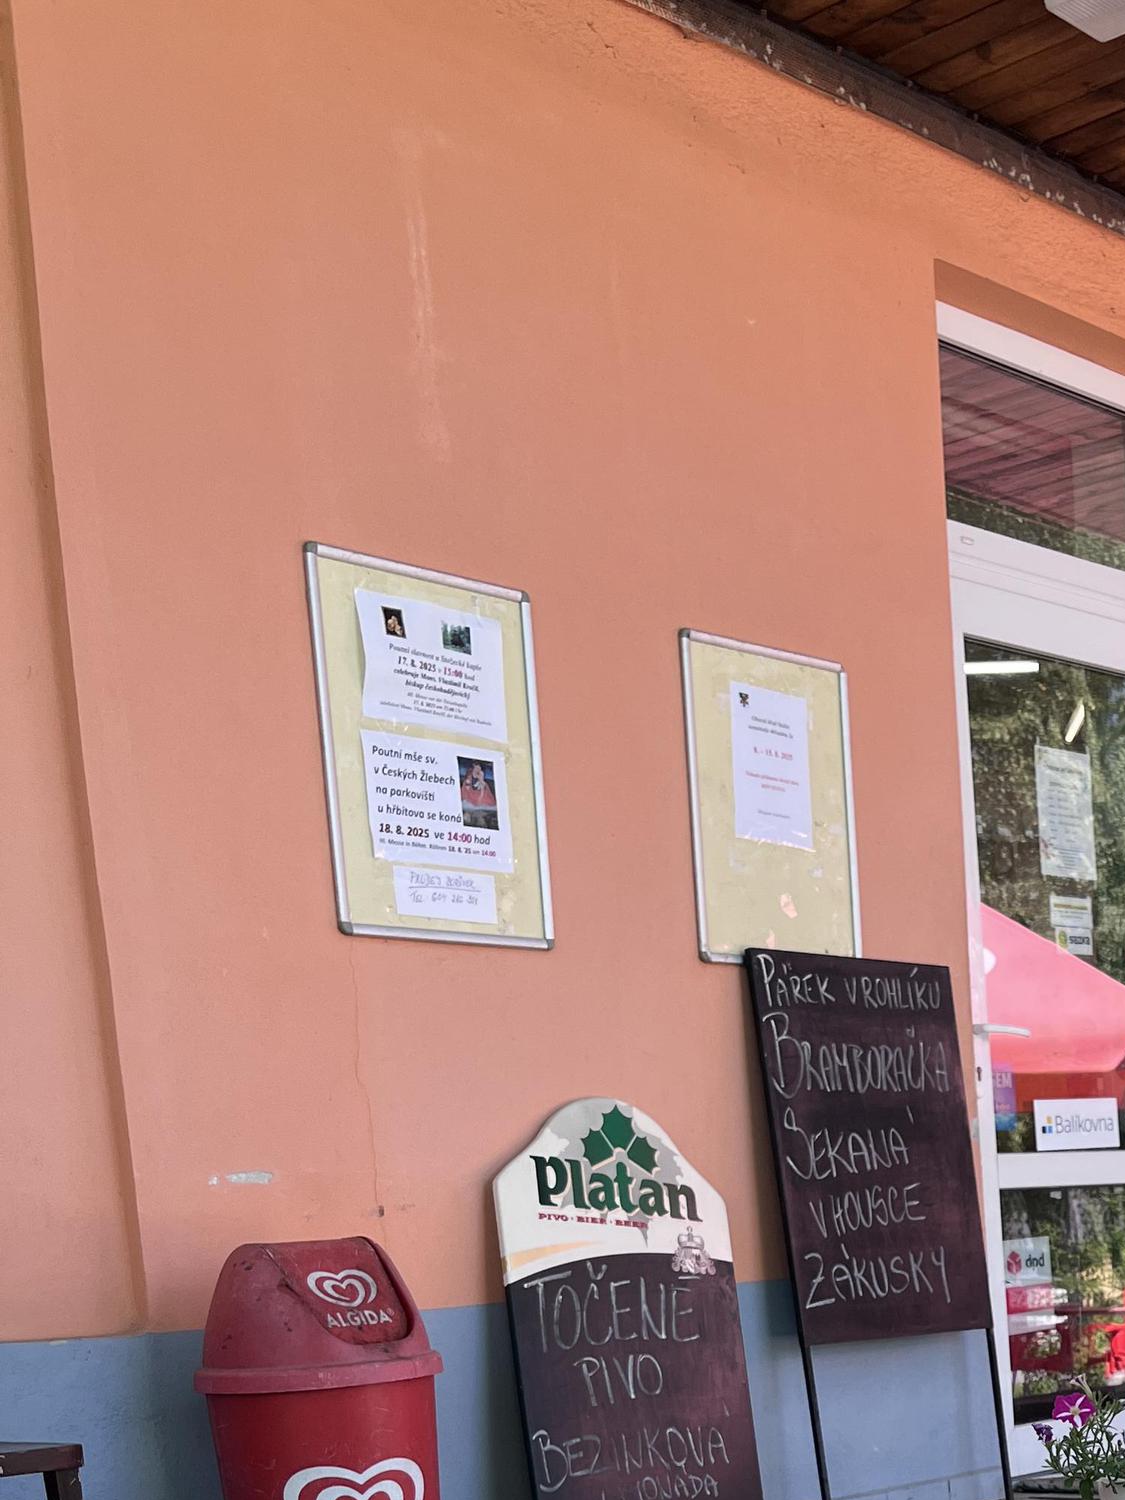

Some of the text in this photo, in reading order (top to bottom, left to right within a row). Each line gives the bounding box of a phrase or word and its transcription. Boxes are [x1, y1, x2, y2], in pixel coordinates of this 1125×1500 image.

[419, 661, 436, 672] 2025
[372, 745, 438, 765] Poutní mše sv.
[382, 763, 418, 780] Českých
[420, 770, 455, 785] Žlebech
[376, 786, 387, 794] na
[377, 803, 462, 823] u hřbitova se koná
[379, 823, 393, 834] 18.
[396, 825, 404, 835] 8.
[407, 826, 429, 838] 2025
[447, 831, 472, 844] 14:00
[474, 834, 491, 845] hod
[762, 1011, 950, 1099] BRAMBORAČKA
[783, 1105, 915, 1180] SEKANÁ
[830, 1182, 926, 1236] HOUSCE
[538, 1212, 648, 1229] PIVO BIER BEER
[804, 1243, 951, 1310] ZÁKUSKY
[327, 1309, 393, 1328] ALGIDA
[573, 1354, 663, 1406] PIVO
